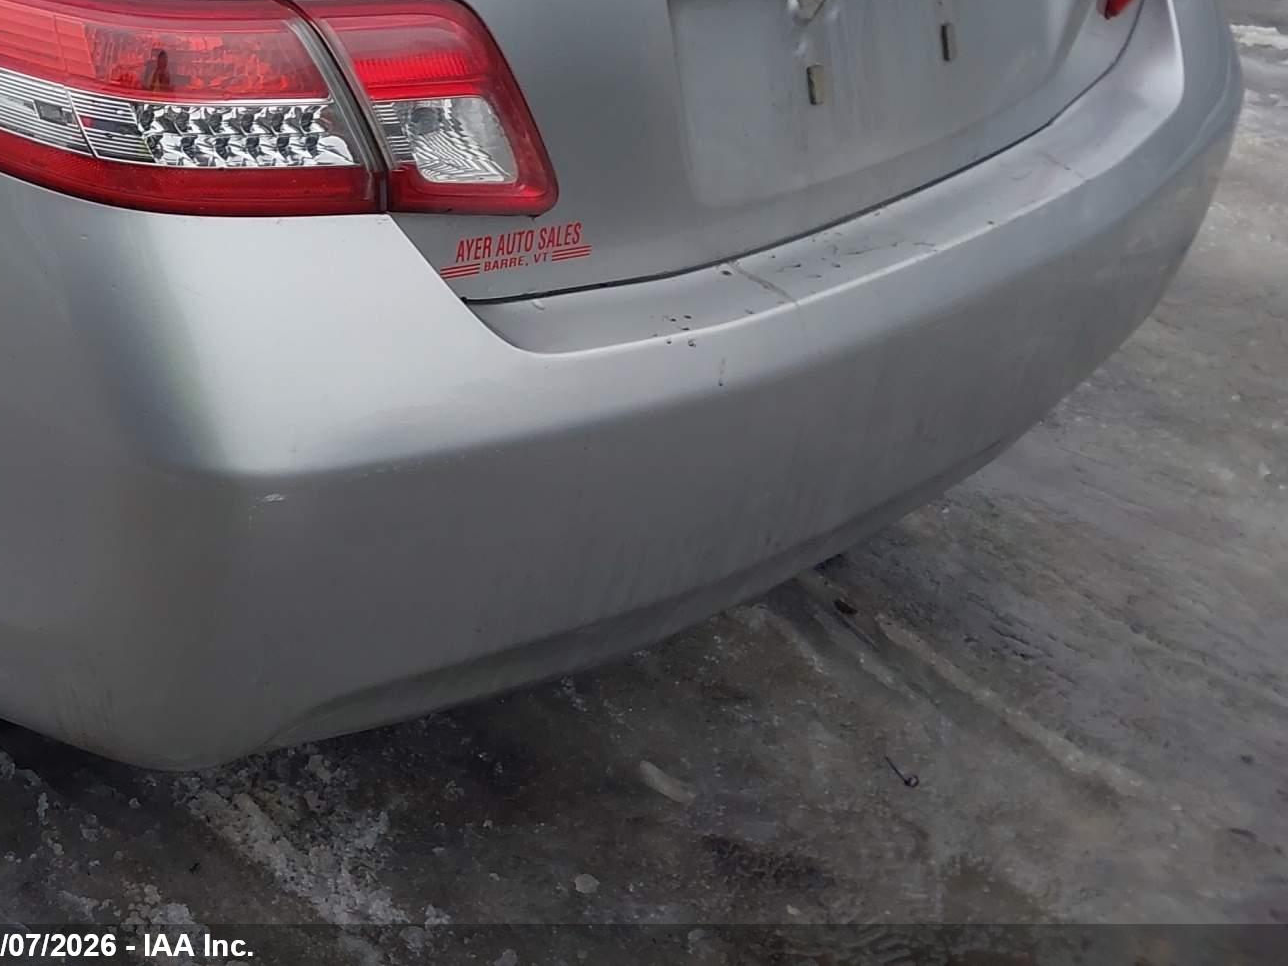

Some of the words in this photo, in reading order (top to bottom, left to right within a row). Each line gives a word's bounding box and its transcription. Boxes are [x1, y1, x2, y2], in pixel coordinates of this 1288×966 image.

[456, 236, 492, 263] AYER
[496, 229, 535, 256] AUTO
[538, 222, 582, 249] SALES
[483, 256, 529, 272] BARRE,
[533, 252, 549, 264] VT
